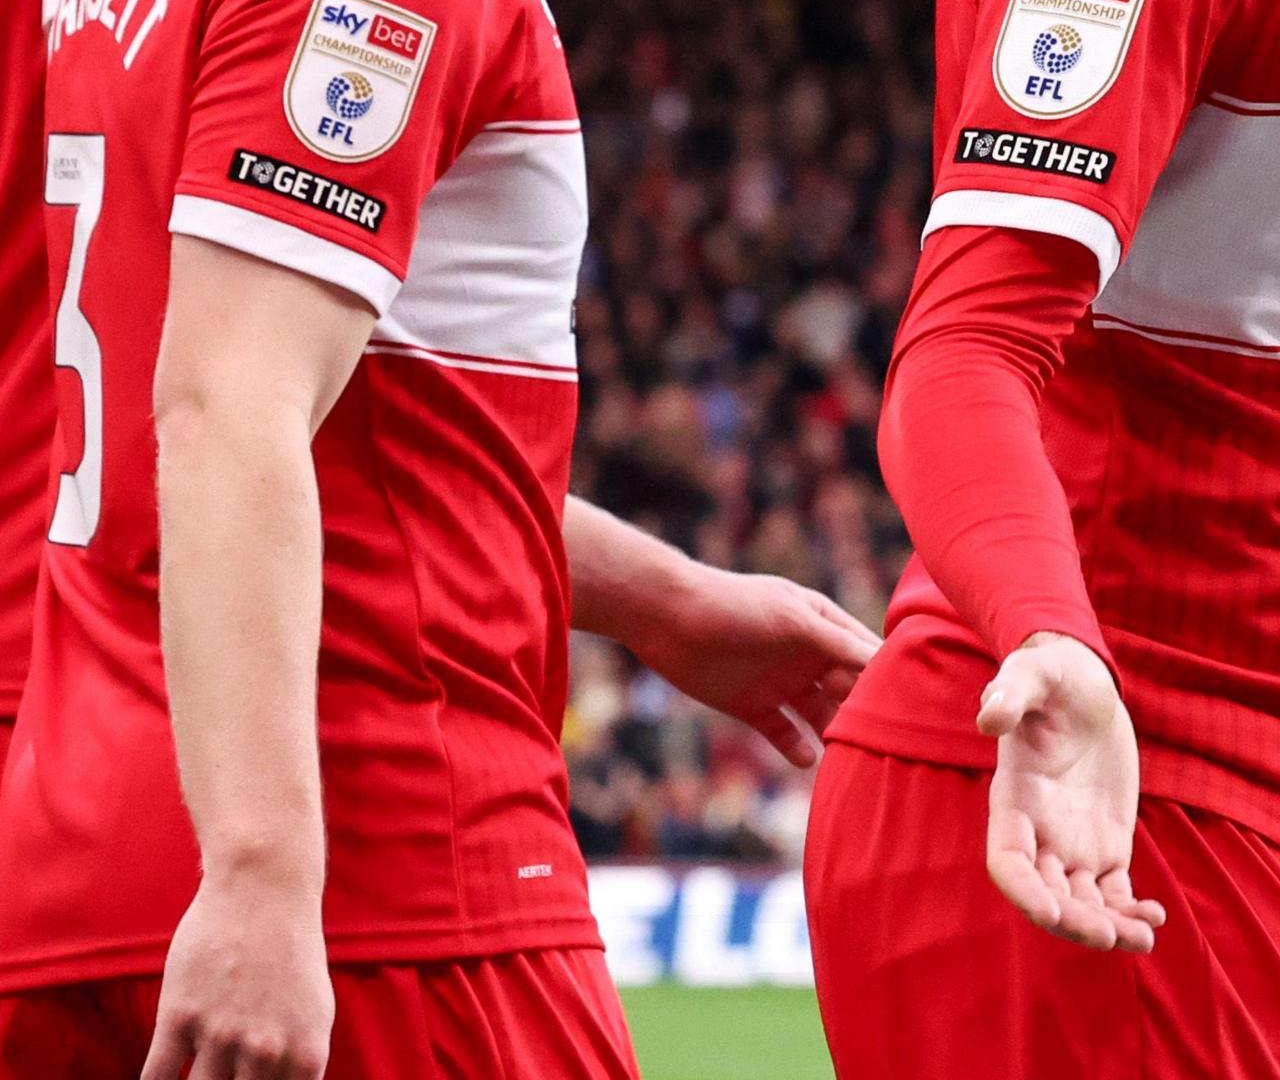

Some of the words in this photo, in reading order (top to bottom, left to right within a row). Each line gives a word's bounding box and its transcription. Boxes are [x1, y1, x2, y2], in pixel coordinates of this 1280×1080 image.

[322, 5, 369, 35] sky
[374, 18, 417, 52] bet
[312, 33, 414, 76] CHAMPIONSHIP
[1024, 75, 1063, 101] EFL
[318, 116, 355, 146] EFL
